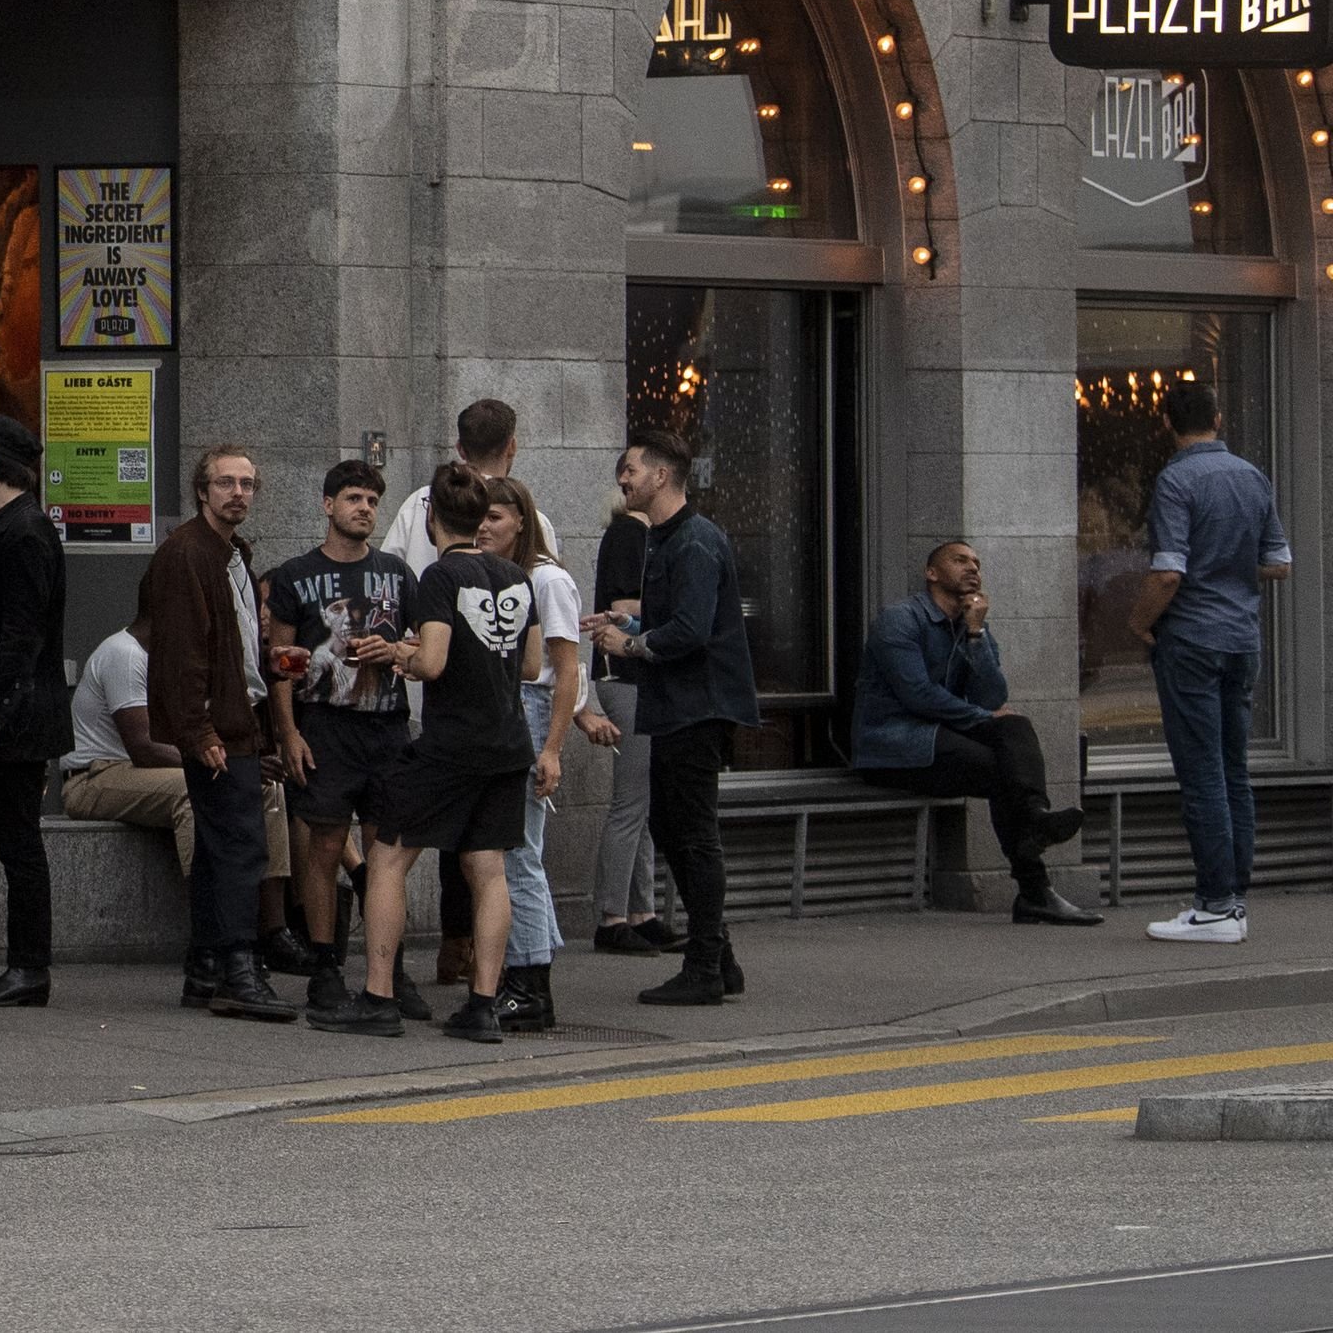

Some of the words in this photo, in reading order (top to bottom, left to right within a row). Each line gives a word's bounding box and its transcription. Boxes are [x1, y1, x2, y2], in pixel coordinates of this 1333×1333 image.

[1091, 76, 1153, 160] LAZA
[1162, 81, 1197, 161] BAR
[99, 182, 130, 201] THE
[85, 203, 144, 222] SECRET
[64, 225, 165, 243] INGREDIENT
[106, 246, 121, 265] IS
[82, 267, 147, 286] ALWAYS
[92, 288, 138, 308] LOVE!
[100, 319, 129, 332] PLAZA
[64, 378, 93, 388] LIEBE
[97, 375, 133, 388] GÄSTE
[76, 448, 107, 456] ENTRY
[68, 510, 82, 518] NO
[85, 510, 116, 518] ENTRY
[293, 572, 342, 604] WE
